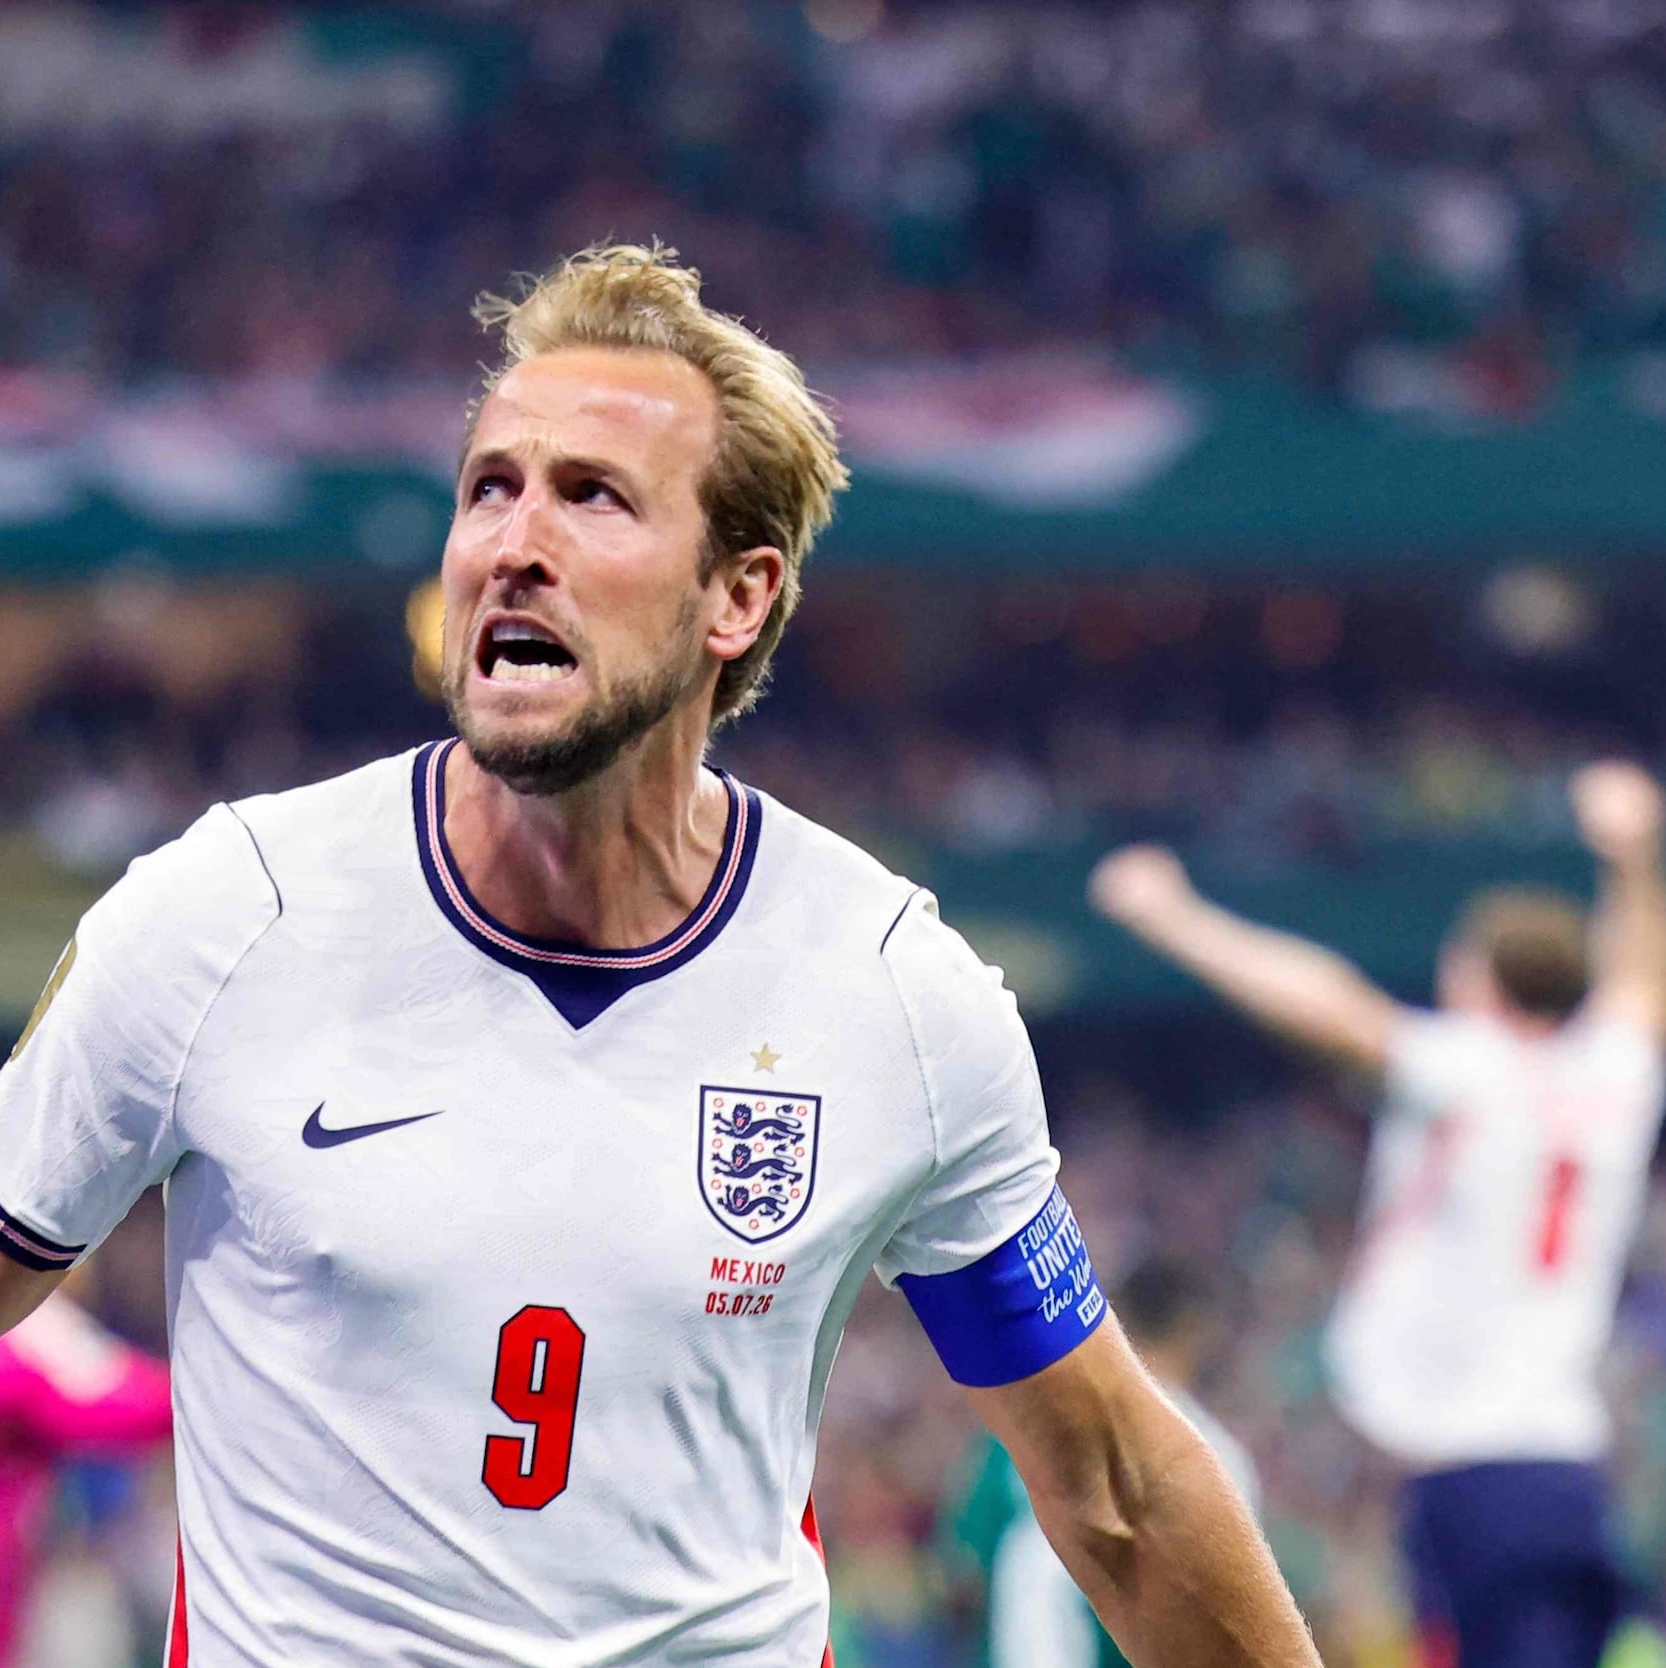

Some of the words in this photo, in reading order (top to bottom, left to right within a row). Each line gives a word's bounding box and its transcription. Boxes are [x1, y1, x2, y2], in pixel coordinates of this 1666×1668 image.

[710, 1256, 786, 1284] MEXICO
[705, 1291, 774, 1316] 05.07.26
[1037, 1288, 1073, 1323] the
[481, 1303, 586, 1511] 9
